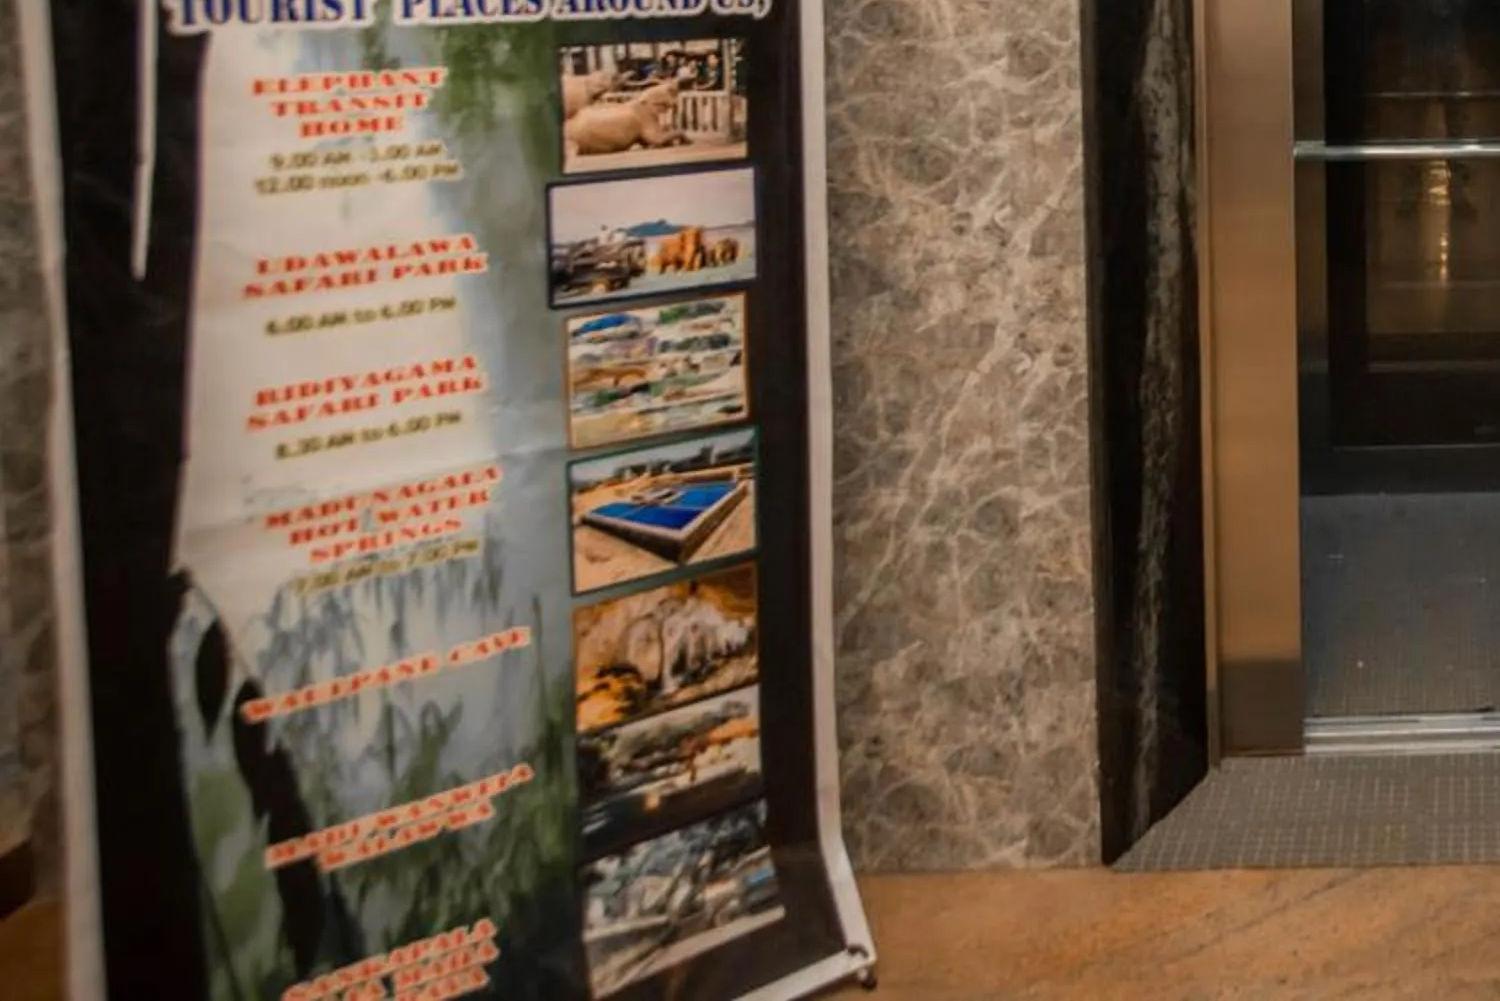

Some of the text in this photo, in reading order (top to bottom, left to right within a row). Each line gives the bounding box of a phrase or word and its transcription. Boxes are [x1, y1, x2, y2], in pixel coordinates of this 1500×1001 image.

[252, 69, 445, 97] ELEPHANT
[270, 91, 429, 117] TRANSIT
[300, 116, 404, 138] HOME
[243, 255, 486, 298] SAFARI PARK
[246, 374, 483, 432] SAFARI PARK
